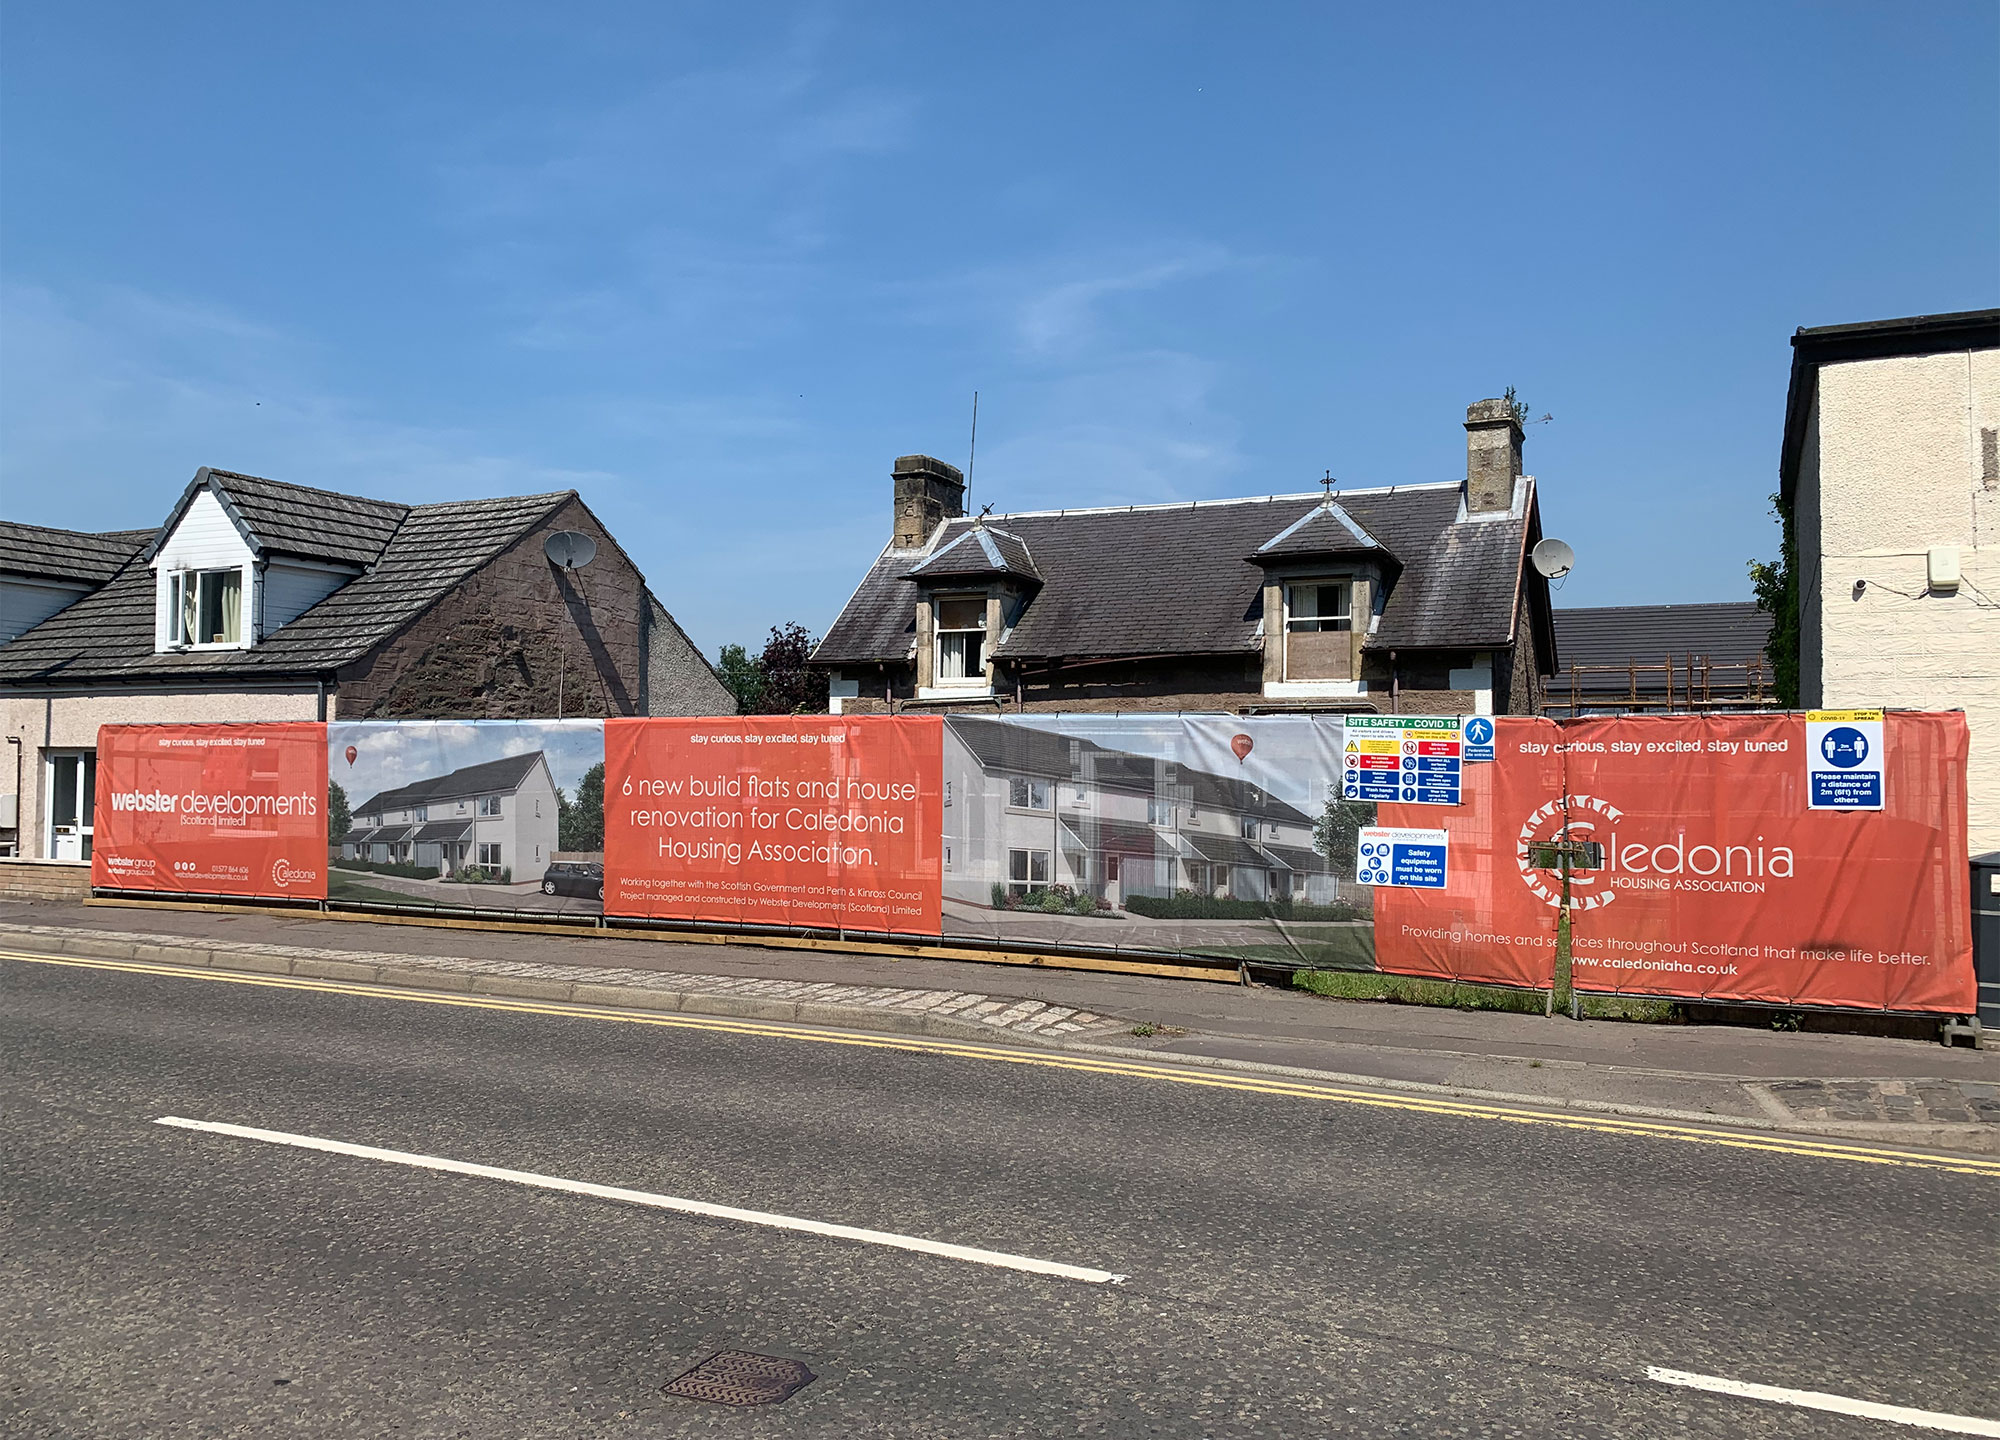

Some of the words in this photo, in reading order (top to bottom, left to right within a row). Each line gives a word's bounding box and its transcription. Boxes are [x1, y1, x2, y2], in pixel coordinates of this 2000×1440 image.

[1371, 719, 1406, 727] SAFETY
[1414, 720, 1444, 728] COVID
[159, 739, 171, 747] stay
[196, 739, 208, 748] stay
[233, 738, 247, 747] stay
[690, 733, 708, 745] stay
[710, 734, 743, 744] curious,
[744, 733, 763, 745] stay
[765, 733, 799, 744] excited,
[800, 733, 820, 745] stay
[821, 733, 846, 743] tuned
[1519, 742, 1549, 756] stay
[1553, 740, 1607, 754] curious,
[1611, 740, 1642, 755] stay
[1646, 740, 1704, 754] excited,
[1707, 740, 1740, 755] stay
[1744, 739, 1788, 752] tuned
[622, 775, 633, 796] 6
[639, 779, 684, 796] new
[690, 775, 741, 797] build
[747, 775, 790, 798] flats
[796, 776, 840, 799] and
[847, 777, 916, 801] house
[111, 789, 179, 813] webster
[180, 790, 317, 826] developments
[630, 806, 744, 828] renovation
[750, 807, 780, 829] for
[786, 808, 904, 834] Caledonia
[1391, 831, 1444, 840] developments
[658, 836, 741, 865] Housing
[747, 839, 879, 866] Association.
[1408, 849, 1430, 858] Safety
[1550, 822, 1794, 886] Cledonia
[108, 857, 134, 866] webster
[134, 860, 156, 870] group
[1401, 858, 1438, 866] equipment
[277, 865, 316, 882] Caledonia
[620, 877, 651, 889] Working
[652, 878, 687, 890] together
[687, 880, 704, 889] with
[706, 880, 720, 889] the
[720, 881, 751, 891] Scottish
[753, 882, 806, 894] Government
[807, 885, 825, 895] and
[826, 886, 846, 896] Perth
[848, 887, 855, 897] &
[857, 887, 886, 899] Kinross
[887, 889, 923, 901] Council
[1610, 876, 1670, 890] HOUSING
[1674, 879, 1766, 893] ASSOCIATION
[620, 890, 645, 900] Project
[646, 893, 683, 903] managed
[685, 893, 700, 902] and
[701, 894, 746, 905] constructed
[748, 898, 758, 907] by
[759, 898, 791, 907] Webster
[792, 899, 846, 911] Developments
[848, 902, 890, 916] (Scotland)
[892, 905, 922, 916] Limited
[1401, 925, 1462, 943] Providing
[1465, 930, 1511, 944] homes
[1514, 935, 1543, 947] and
[1546, 935, 1603, 948] seices
[1607, 937, 1688, 955] throughout
[1691, 941, 1759, 958] Scotland
[1764, 945, 1796, 960] that
[1800, 948, 1846, 961] make
[1850, 949, 1873, 963] life
[1878, 951, 1931, 966] better.
